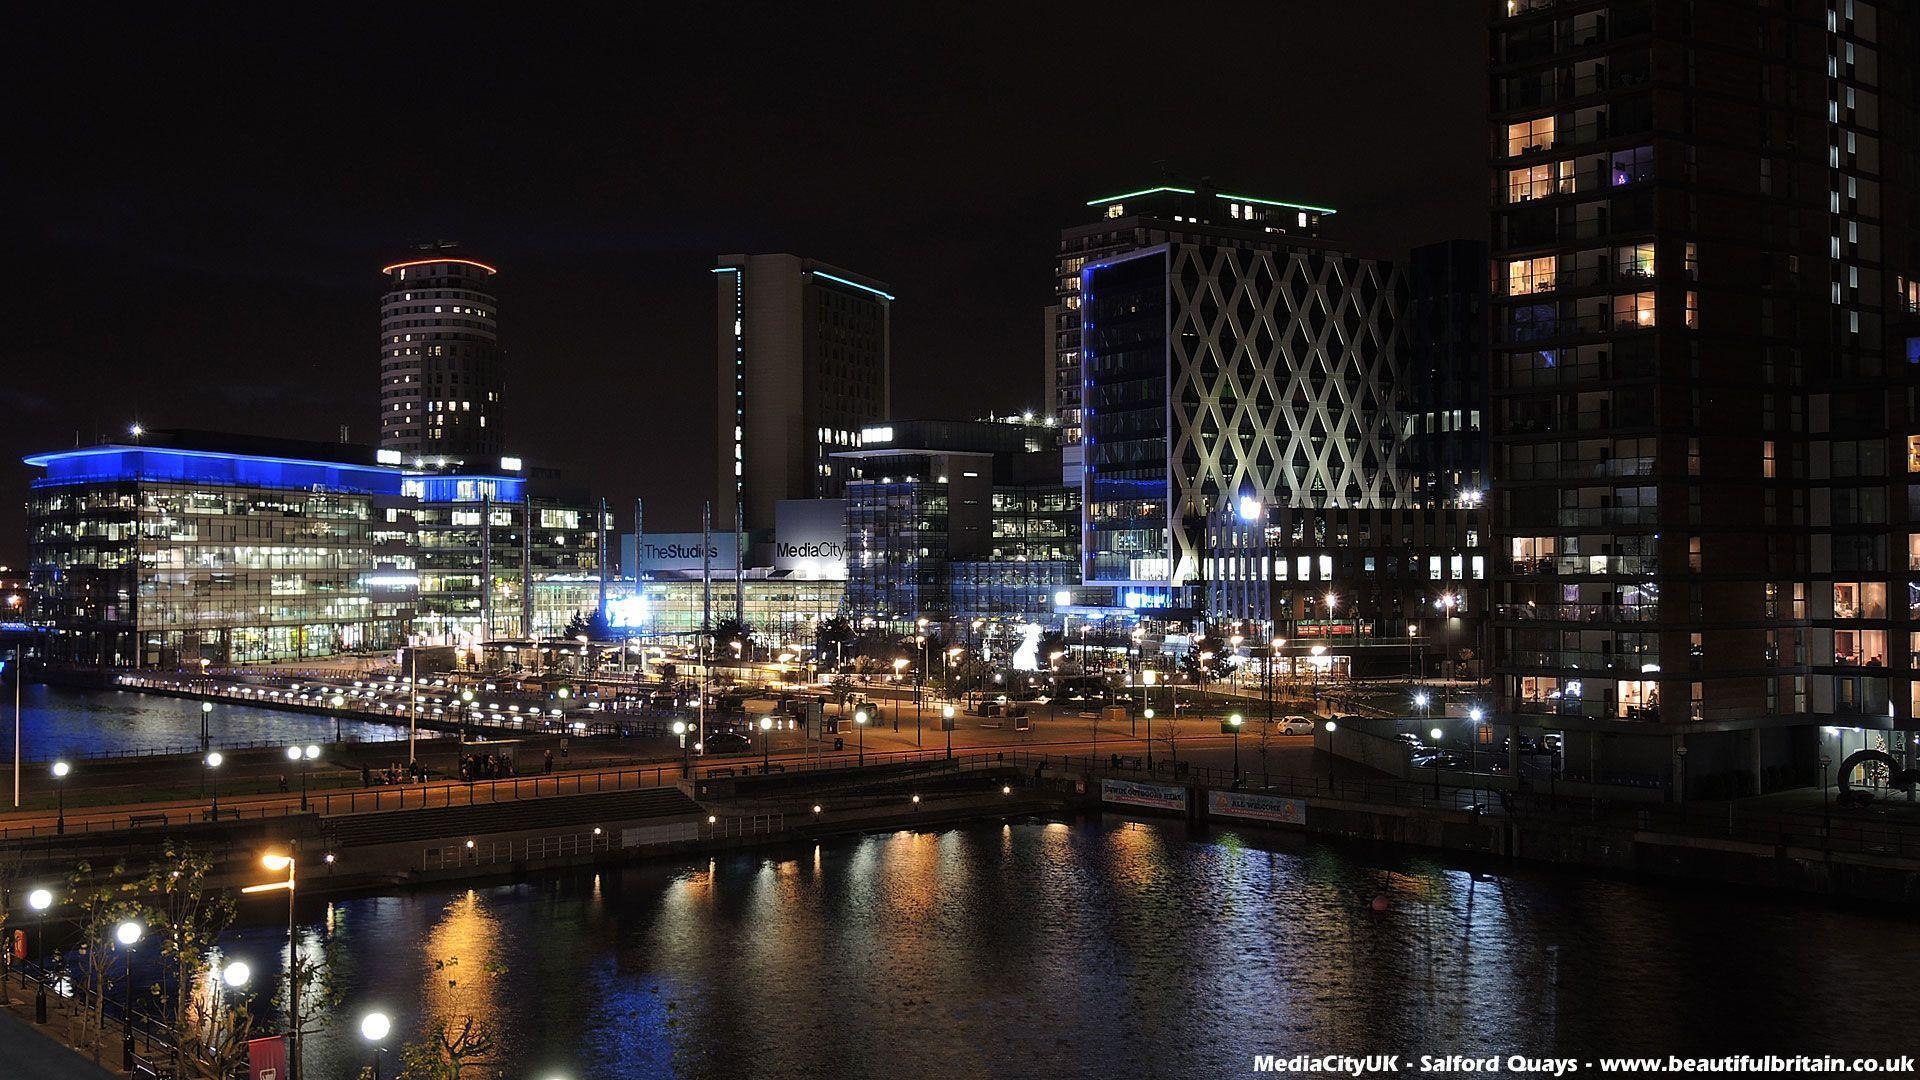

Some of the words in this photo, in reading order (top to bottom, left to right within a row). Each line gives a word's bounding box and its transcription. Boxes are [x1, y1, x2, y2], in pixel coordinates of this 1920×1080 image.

[777, 542, 846, 561] MediaCity
[1232, 800, 1246, 808] ALL
[1248, 802, 1281, 812] WELCOME
